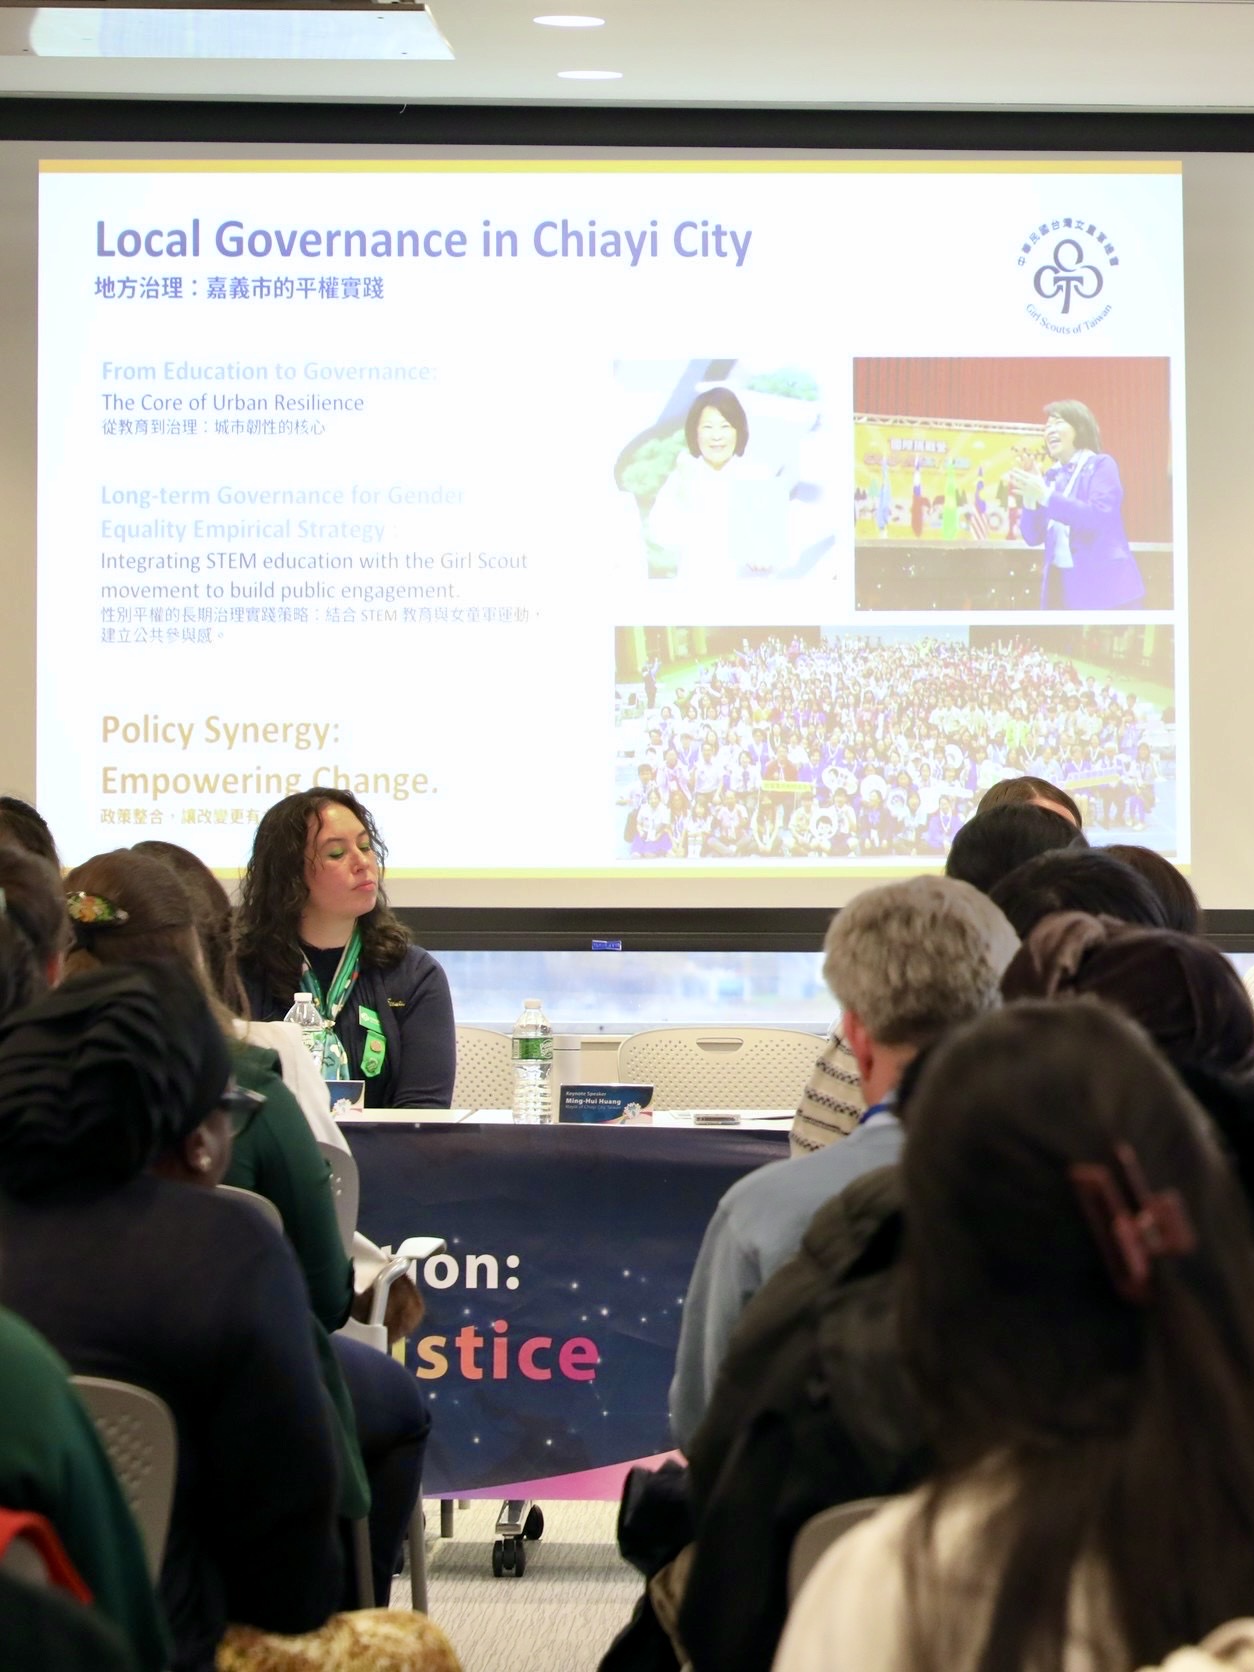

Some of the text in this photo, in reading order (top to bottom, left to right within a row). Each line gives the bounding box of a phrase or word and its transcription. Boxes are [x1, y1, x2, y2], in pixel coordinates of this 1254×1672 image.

[96, 219, 753, 267] Local Governance in Chiayi City
[94, 275, 384, 300] 地方治理：嘉義市的平權實踐
[1026, 303, 1112, 335] Girl Scouts of Taiwan
[102, 360, 438, 381] From Education to Governance:
[102, 393, 364, 411] The Core of Urban Resilience
[101, 485, 465, 511] Long-term Governance for Gender
[101, 519, 186, 543] Equality
[194, 519, 291, 543] Empirical
[101, 552, 528, 574] Integrating STEM education with the Girl Scout
[101, 581, 460, 603] movement to build public engagement.
[361, 609, 397, 622] STEM
[102, 715, 340, 750] Policy Synergy:
[102, 765, 438, 801] Empowering Change.
[100, 807, 267, 825] 政策整合，讓改變更有
[380, 1244, 521, 1290] on:
[391, 1319, 600, 1381] stice
